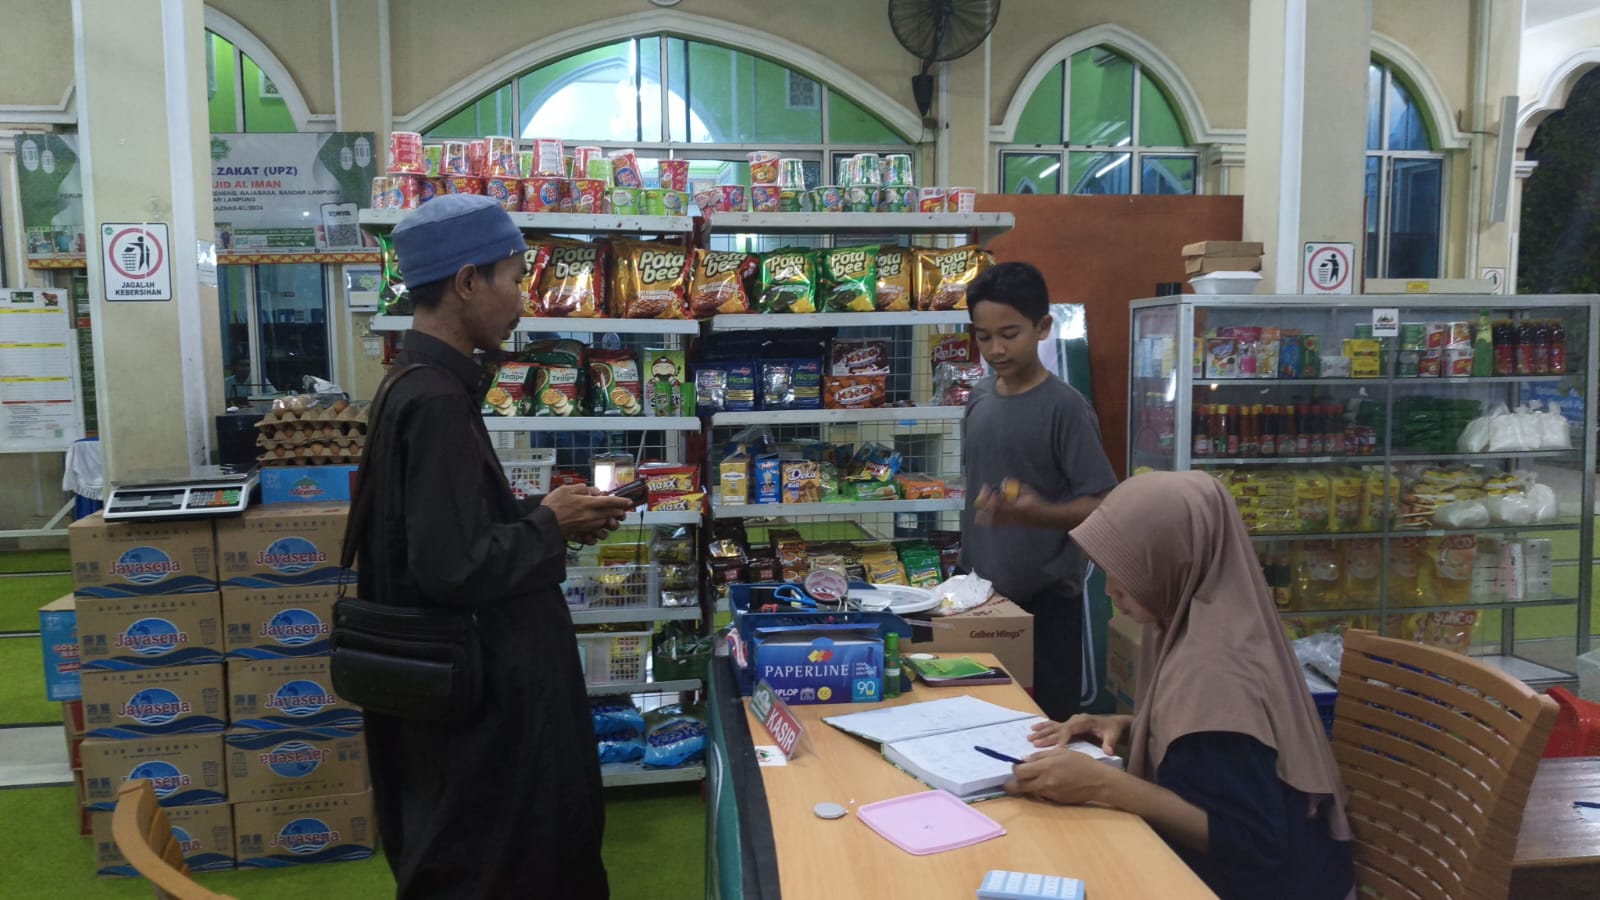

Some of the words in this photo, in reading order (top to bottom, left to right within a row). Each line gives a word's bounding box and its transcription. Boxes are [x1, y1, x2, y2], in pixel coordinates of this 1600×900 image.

[217, 167, 259, 175] ZAKAT
[264, 167, 298, 176] (UPZ)
[212, 180, 231, 188] JID
[551, 247, 597, 266] Pota
[639, 251, 686, 270] Pota
[703, 253, 748, 266] Pota
[770, 255, 805, 272] Pota
[831, 251, 866, 267] Pota
[936, 250, 967, 267] Pota
[555, 262, 594, 279] bee
[642, 266, 679, 284] bee
[706, 259, 741, 278] bee
[774, 264, 805, 282] bee
[832, 262, 864, 280] bee
[940, 261, 967, 278] bee
[115, 289, 161, 297] KEBERSIHAN
[256, 551, 328, 567] Jayasena
[107, 560, 182, 578] Jayasena
[260, 623, 330, 638] Jayasena
[114, 631, 189, 649] Jayasena
[764, 664, 849, 679] PAPERLINE
[774, 688, 799, 698] PLOP
[857, 681, 875, 696] 90
[117, 700, 191, 717] Jayasena
[265, 692, 336, 708] Jayasena
[765, 708, 796, 753] KASIR
[268, 830, 342, 848] Jayasena
